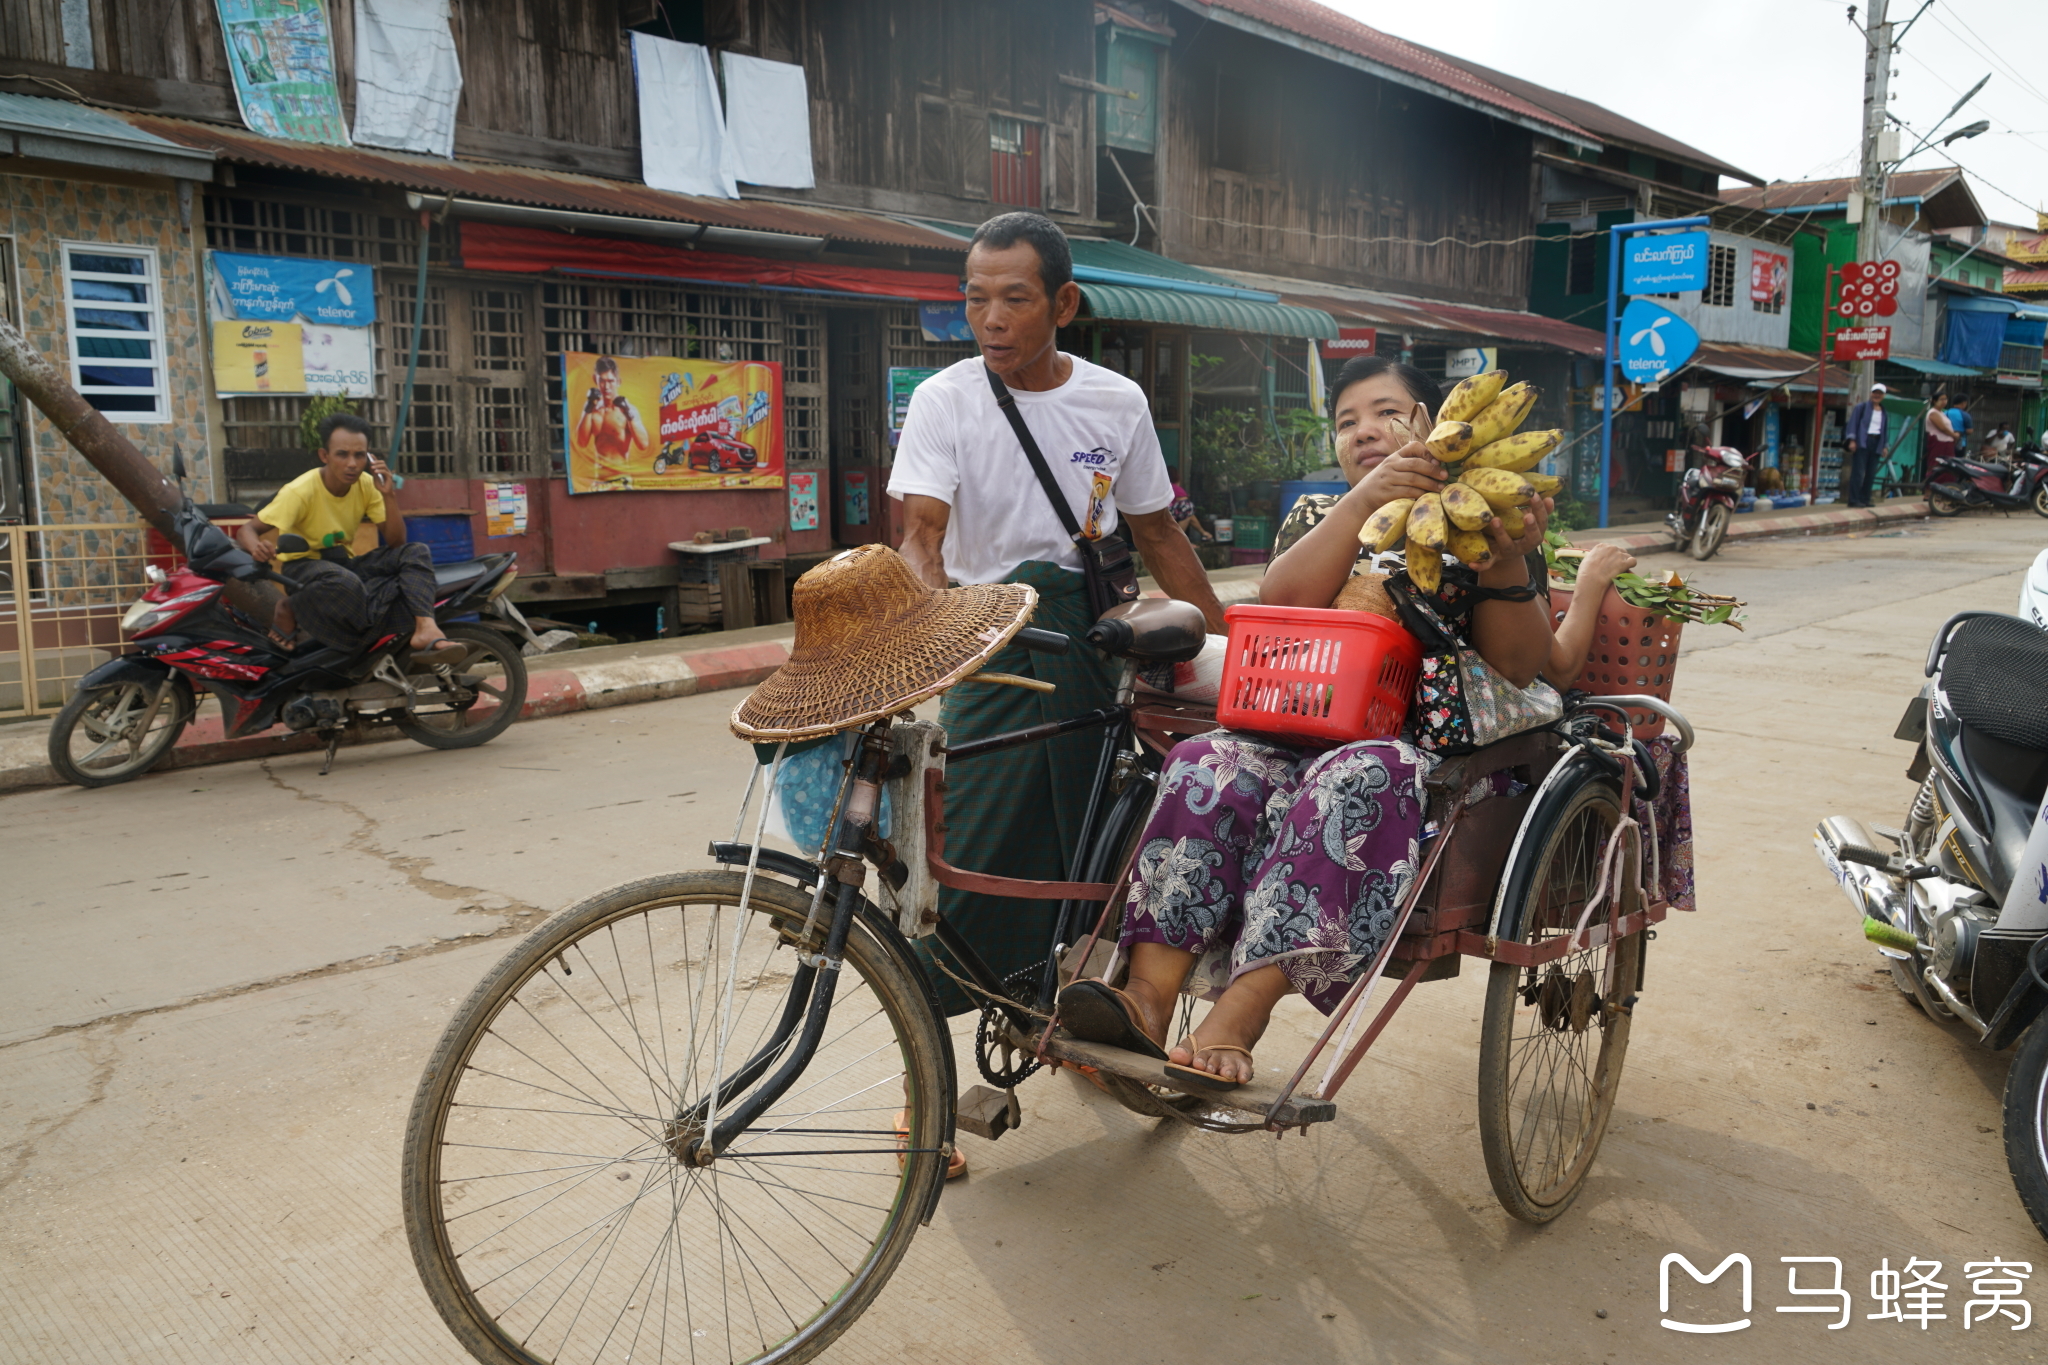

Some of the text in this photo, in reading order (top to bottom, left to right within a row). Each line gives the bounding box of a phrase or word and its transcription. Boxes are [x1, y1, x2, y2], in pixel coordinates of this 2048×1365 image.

[317, 306, 356, 319] telenor
[1456, 357, 1477, 367] MPT
[1628, 357, 1668, 370] telenor
[663, 384, 682, 408] LION
[747, 405, 769, 430] LION
[1070, 451, 1105, 465] SPEED
